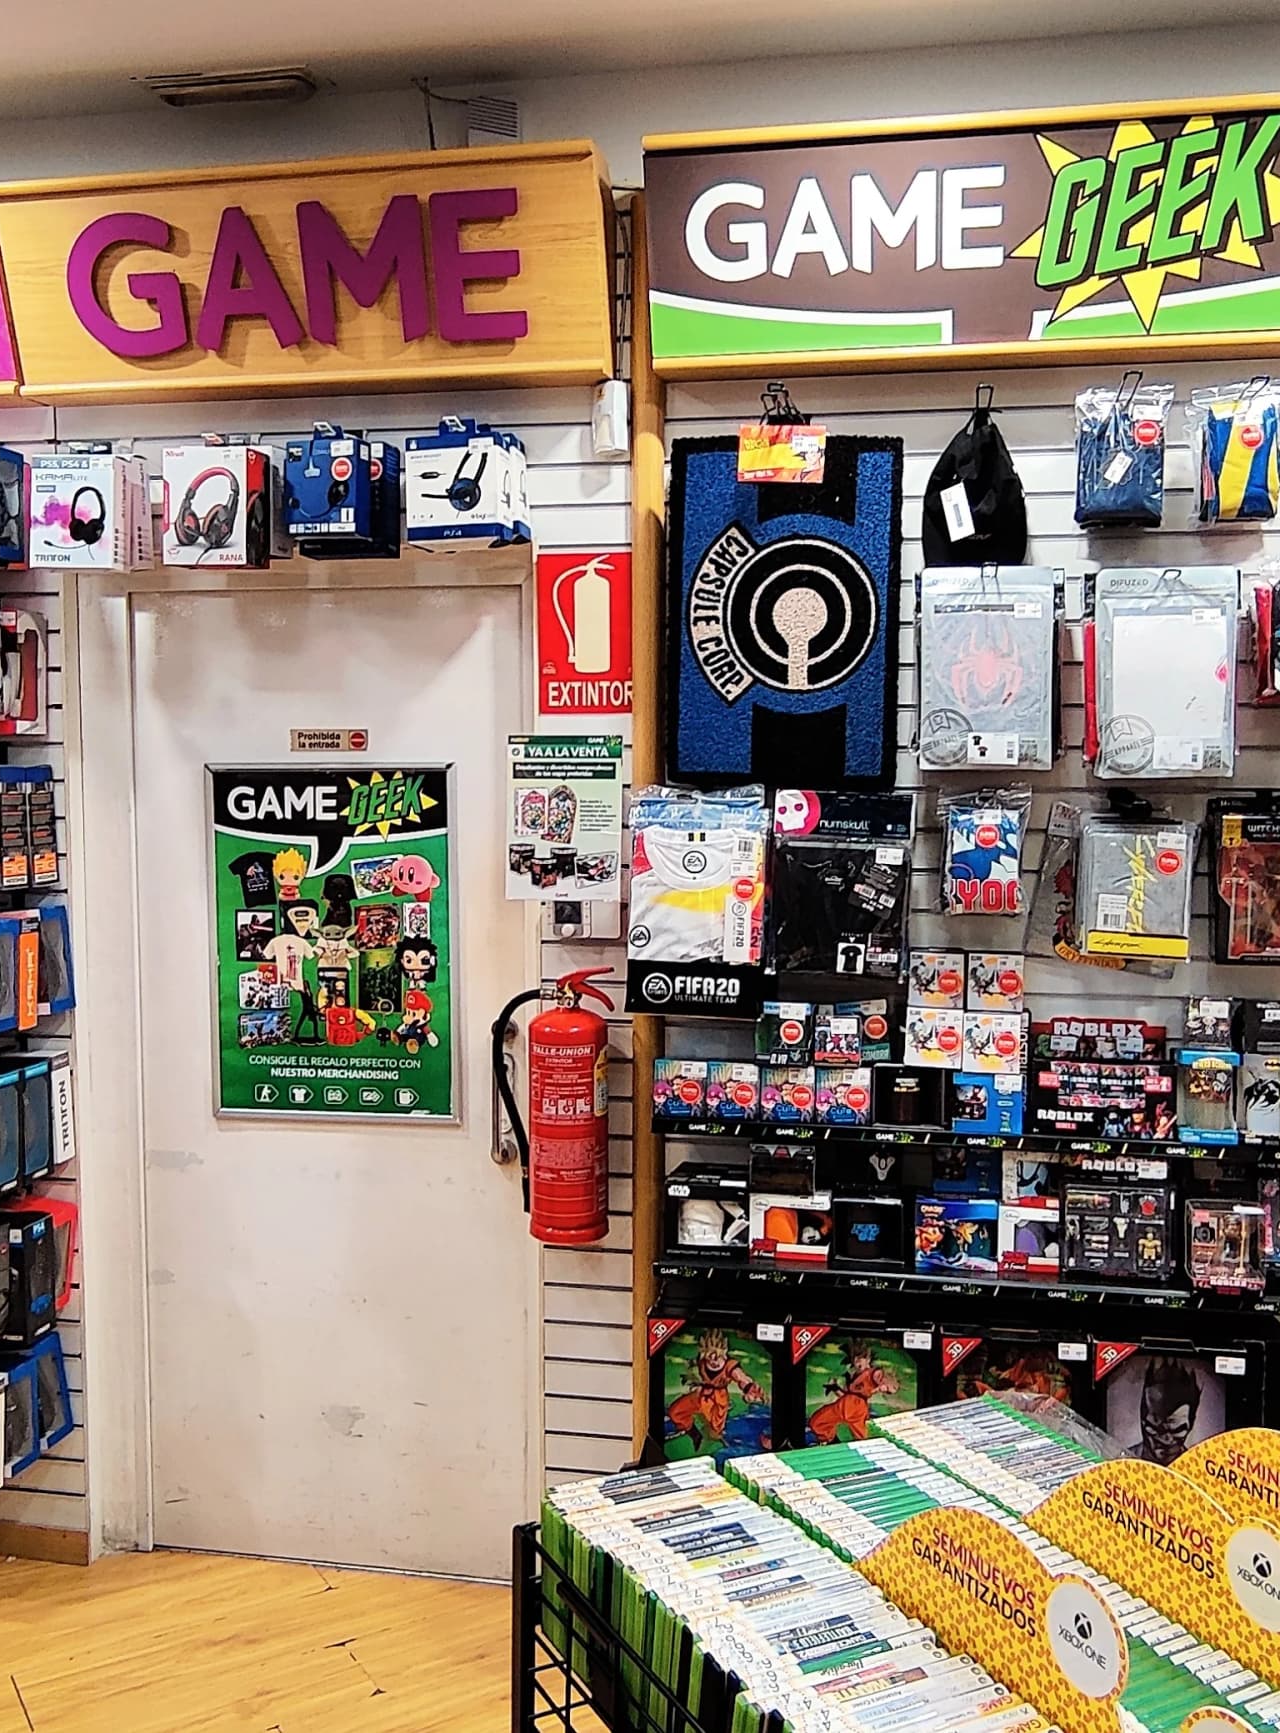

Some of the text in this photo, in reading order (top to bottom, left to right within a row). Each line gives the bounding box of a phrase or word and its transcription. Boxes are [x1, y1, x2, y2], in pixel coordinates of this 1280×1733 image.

[684, 163, 1007, 282] GAME
[67, 187, 529, 359] GAME
[443, 528, 462, 537] PS4
[35, 553, 71, 562] TRITTON
[219, 553, 243, 562] RANA
[693, 533, 750, 695] CAPSULE CORP.
[548, 680, 632, 707] EXTINTOR
[298, 732, 340, 741] Prohibida
[298, 741, 340, 749] la entrada
[528, 747, 608, 756] YA A LA VENTA
[227, 775, 424, 825] GAME GEEK
[819, 819, 870, 831] numskull
[674, 995, 737, 1004] ULTIMATE TEAM
[1054, 1021, 1144, 1037] ROBLOX
[249, 1055, 421, 1068] CONSIGUE EL REGALO PERFECTO CON
[271, 1067, 399, 1079] NUESTRO MERCHANDISING
[1037, 1109, 1094, 1121] ROBLOX
[653, 1324, 668, 1339] 3D
[1103, 1348, 1118, 1363] 3D
[1104, 1480, 1215, 1555] SEMINUEVOS
[1081, 1490, 1216, 1580] GARANTIZADOS
[933, 1527, 1037, 1611] SEMINUEVOS
[1237, 1565, 1265, 1592] XBOX
[911, 1537, 1038, 1638] GARANTIZADOS
[1057, 1624, 1106, 1670] XBOX ONE
